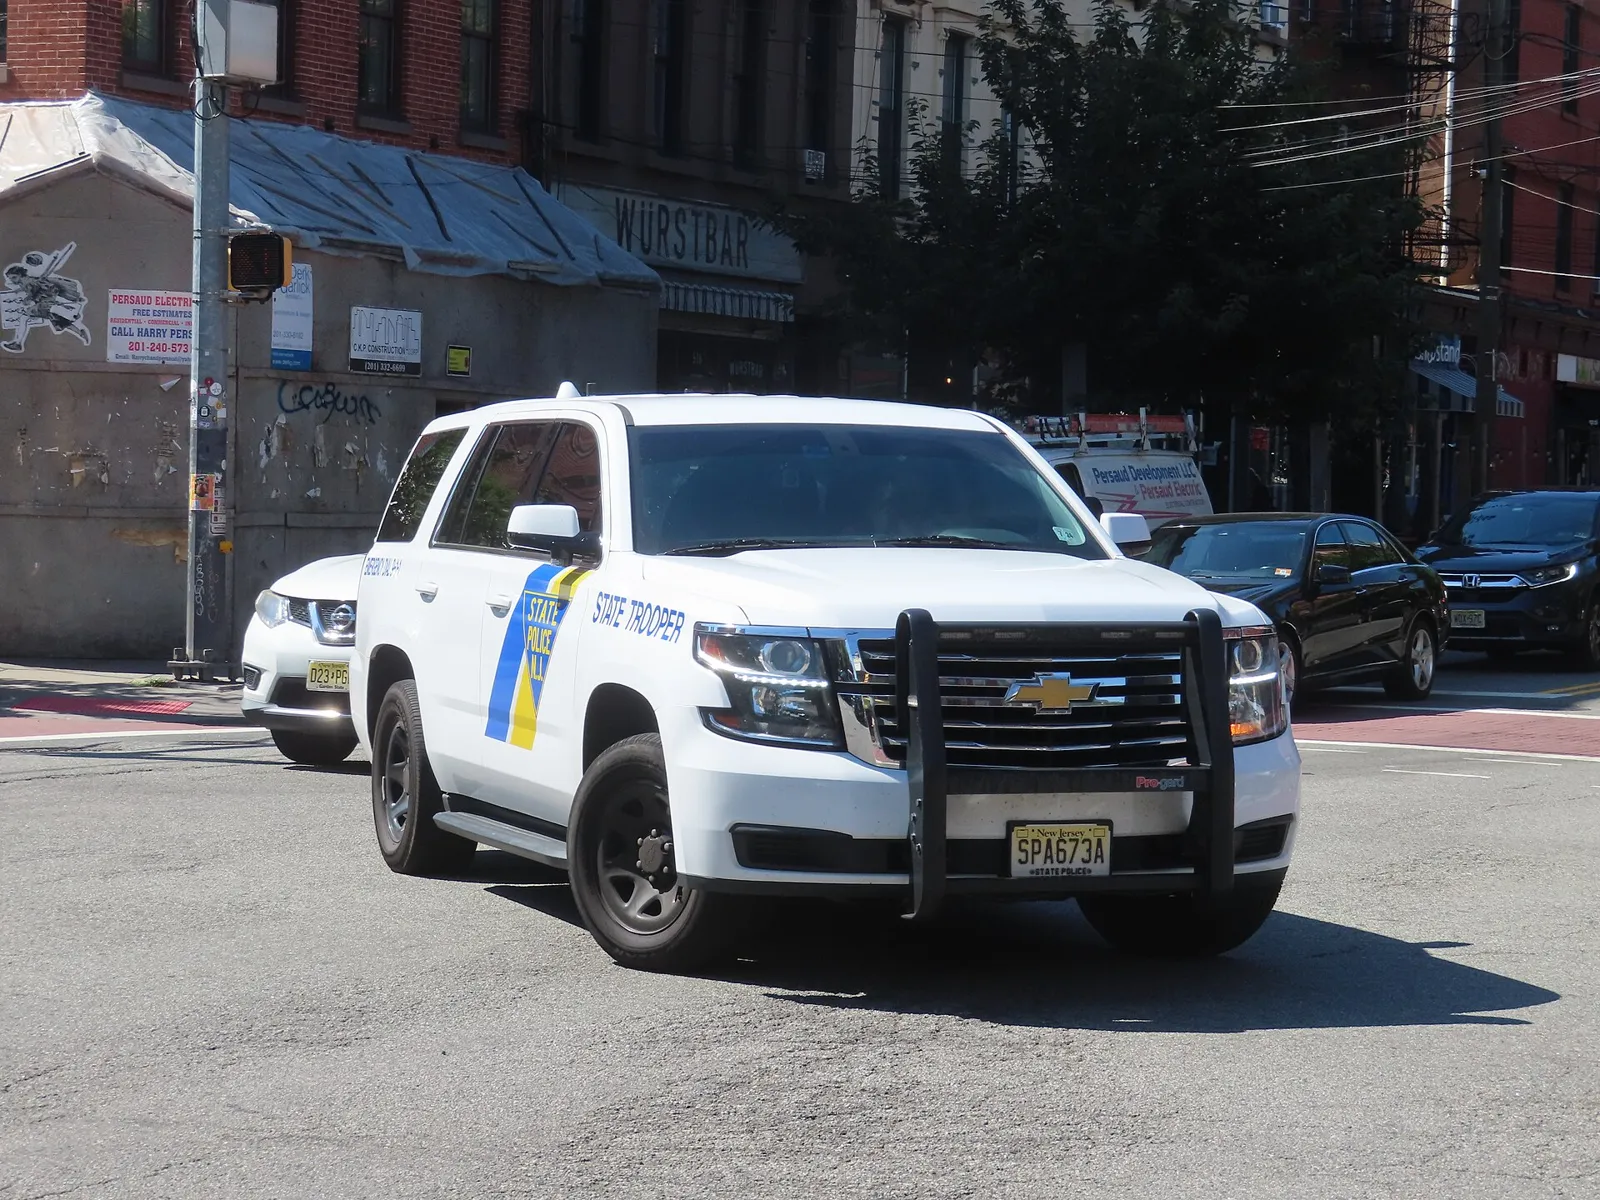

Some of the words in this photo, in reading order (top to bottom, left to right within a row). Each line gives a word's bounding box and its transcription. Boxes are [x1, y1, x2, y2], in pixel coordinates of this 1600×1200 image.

[112, 294, 152, 306] PERSAUD
[155, 296, 192, 307] ELECTRI
[132, 308, 151, 317] FREE
[152, 309, 192, 318] ESTIMATES
[110, 317, 143, 325] RESIDENTIAL
[111, 326, 135, 337] CALL
[137, 327, 168, 338] HARRY
[128, 341, 192, 353] 201-240-573
[367, 345, 406, 355] CONSTRUCTION
[364, 362, 379, 372] (201)
[1092, 466, 1129, 484] Persaud
[1128, 464, 1181, 483] Development
[1179, 462, 1196, 478] LLC
[1139, 481, 1174, 500] Persaud
[1174, 480, 1202, 496] Electric
[527, 597, 559, 627] STATE
[592, 591, 627, 628] STATE
[625, 599, 685, 643] TROOPER
[526, 625, 553, 656] POLICE
[1037, 828, 1058, 838] New
[1059, 828, 1086, 841] Jersey
[1018, 838, 1105, 865] SPA673A
[1035, 867, 1060, 876] STATE
[1061, 867, 1087, 876] POLICE
